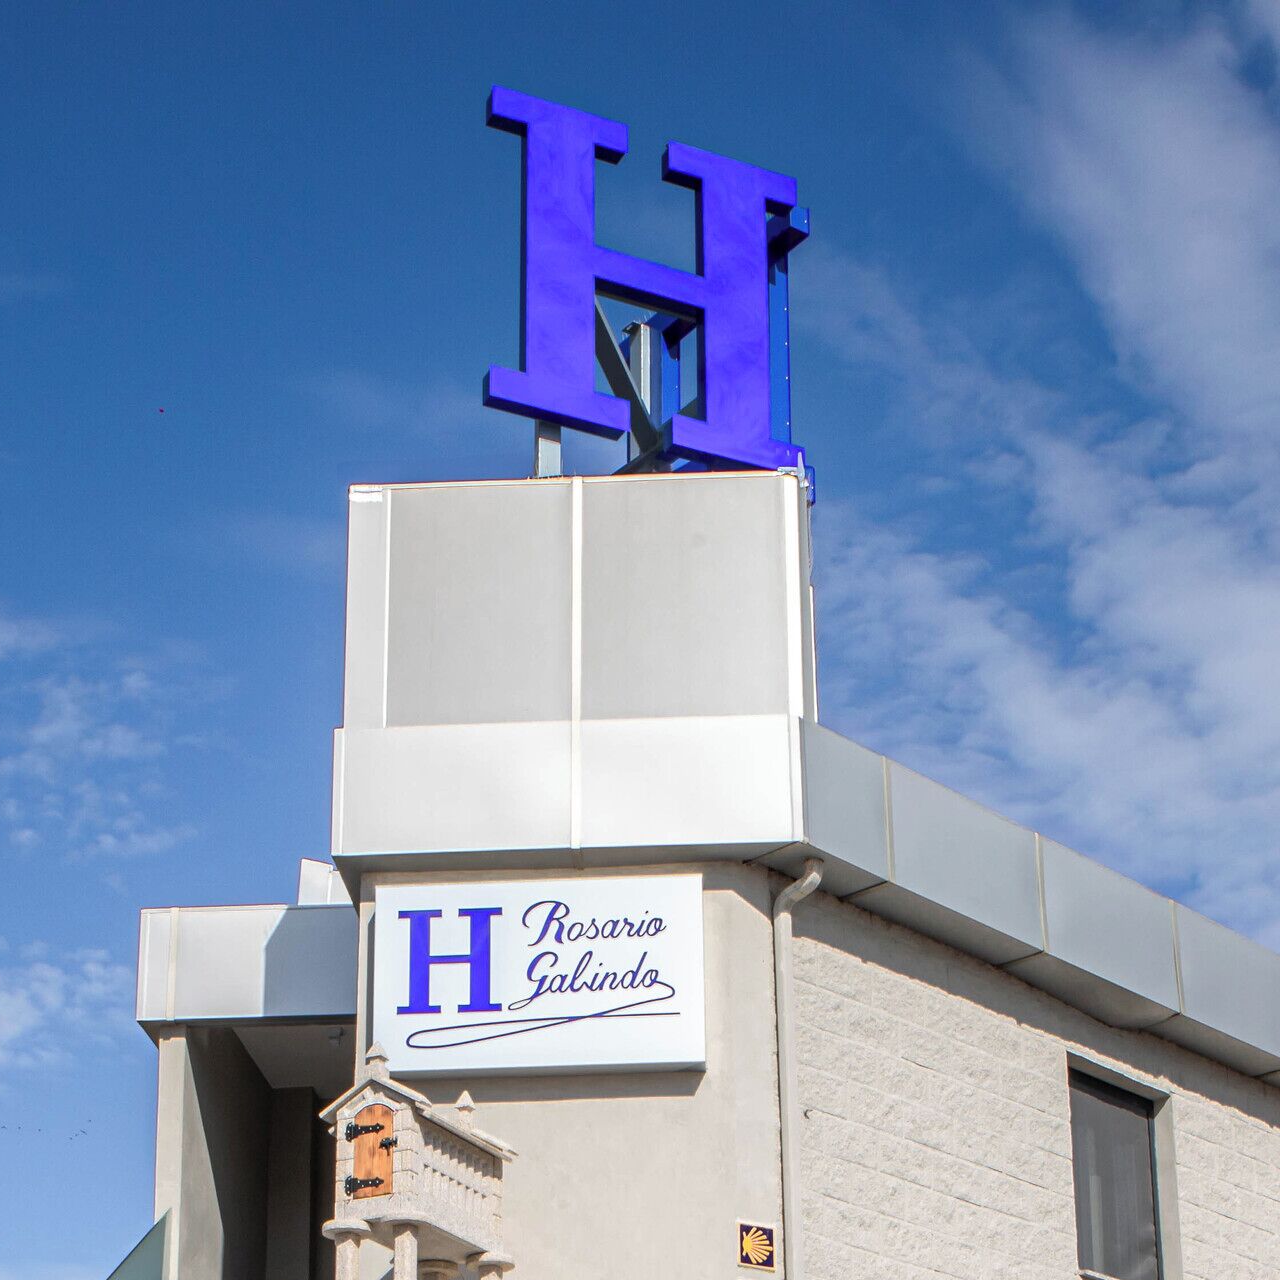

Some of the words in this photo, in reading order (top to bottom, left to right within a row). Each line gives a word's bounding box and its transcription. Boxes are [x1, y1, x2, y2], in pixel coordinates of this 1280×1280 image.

[483, 85, 804, 471] H
[396, 906, 503, 1015] H
[521, 899, 667, 947] Rosario
[508, 951, 675, 1011] Galindo
